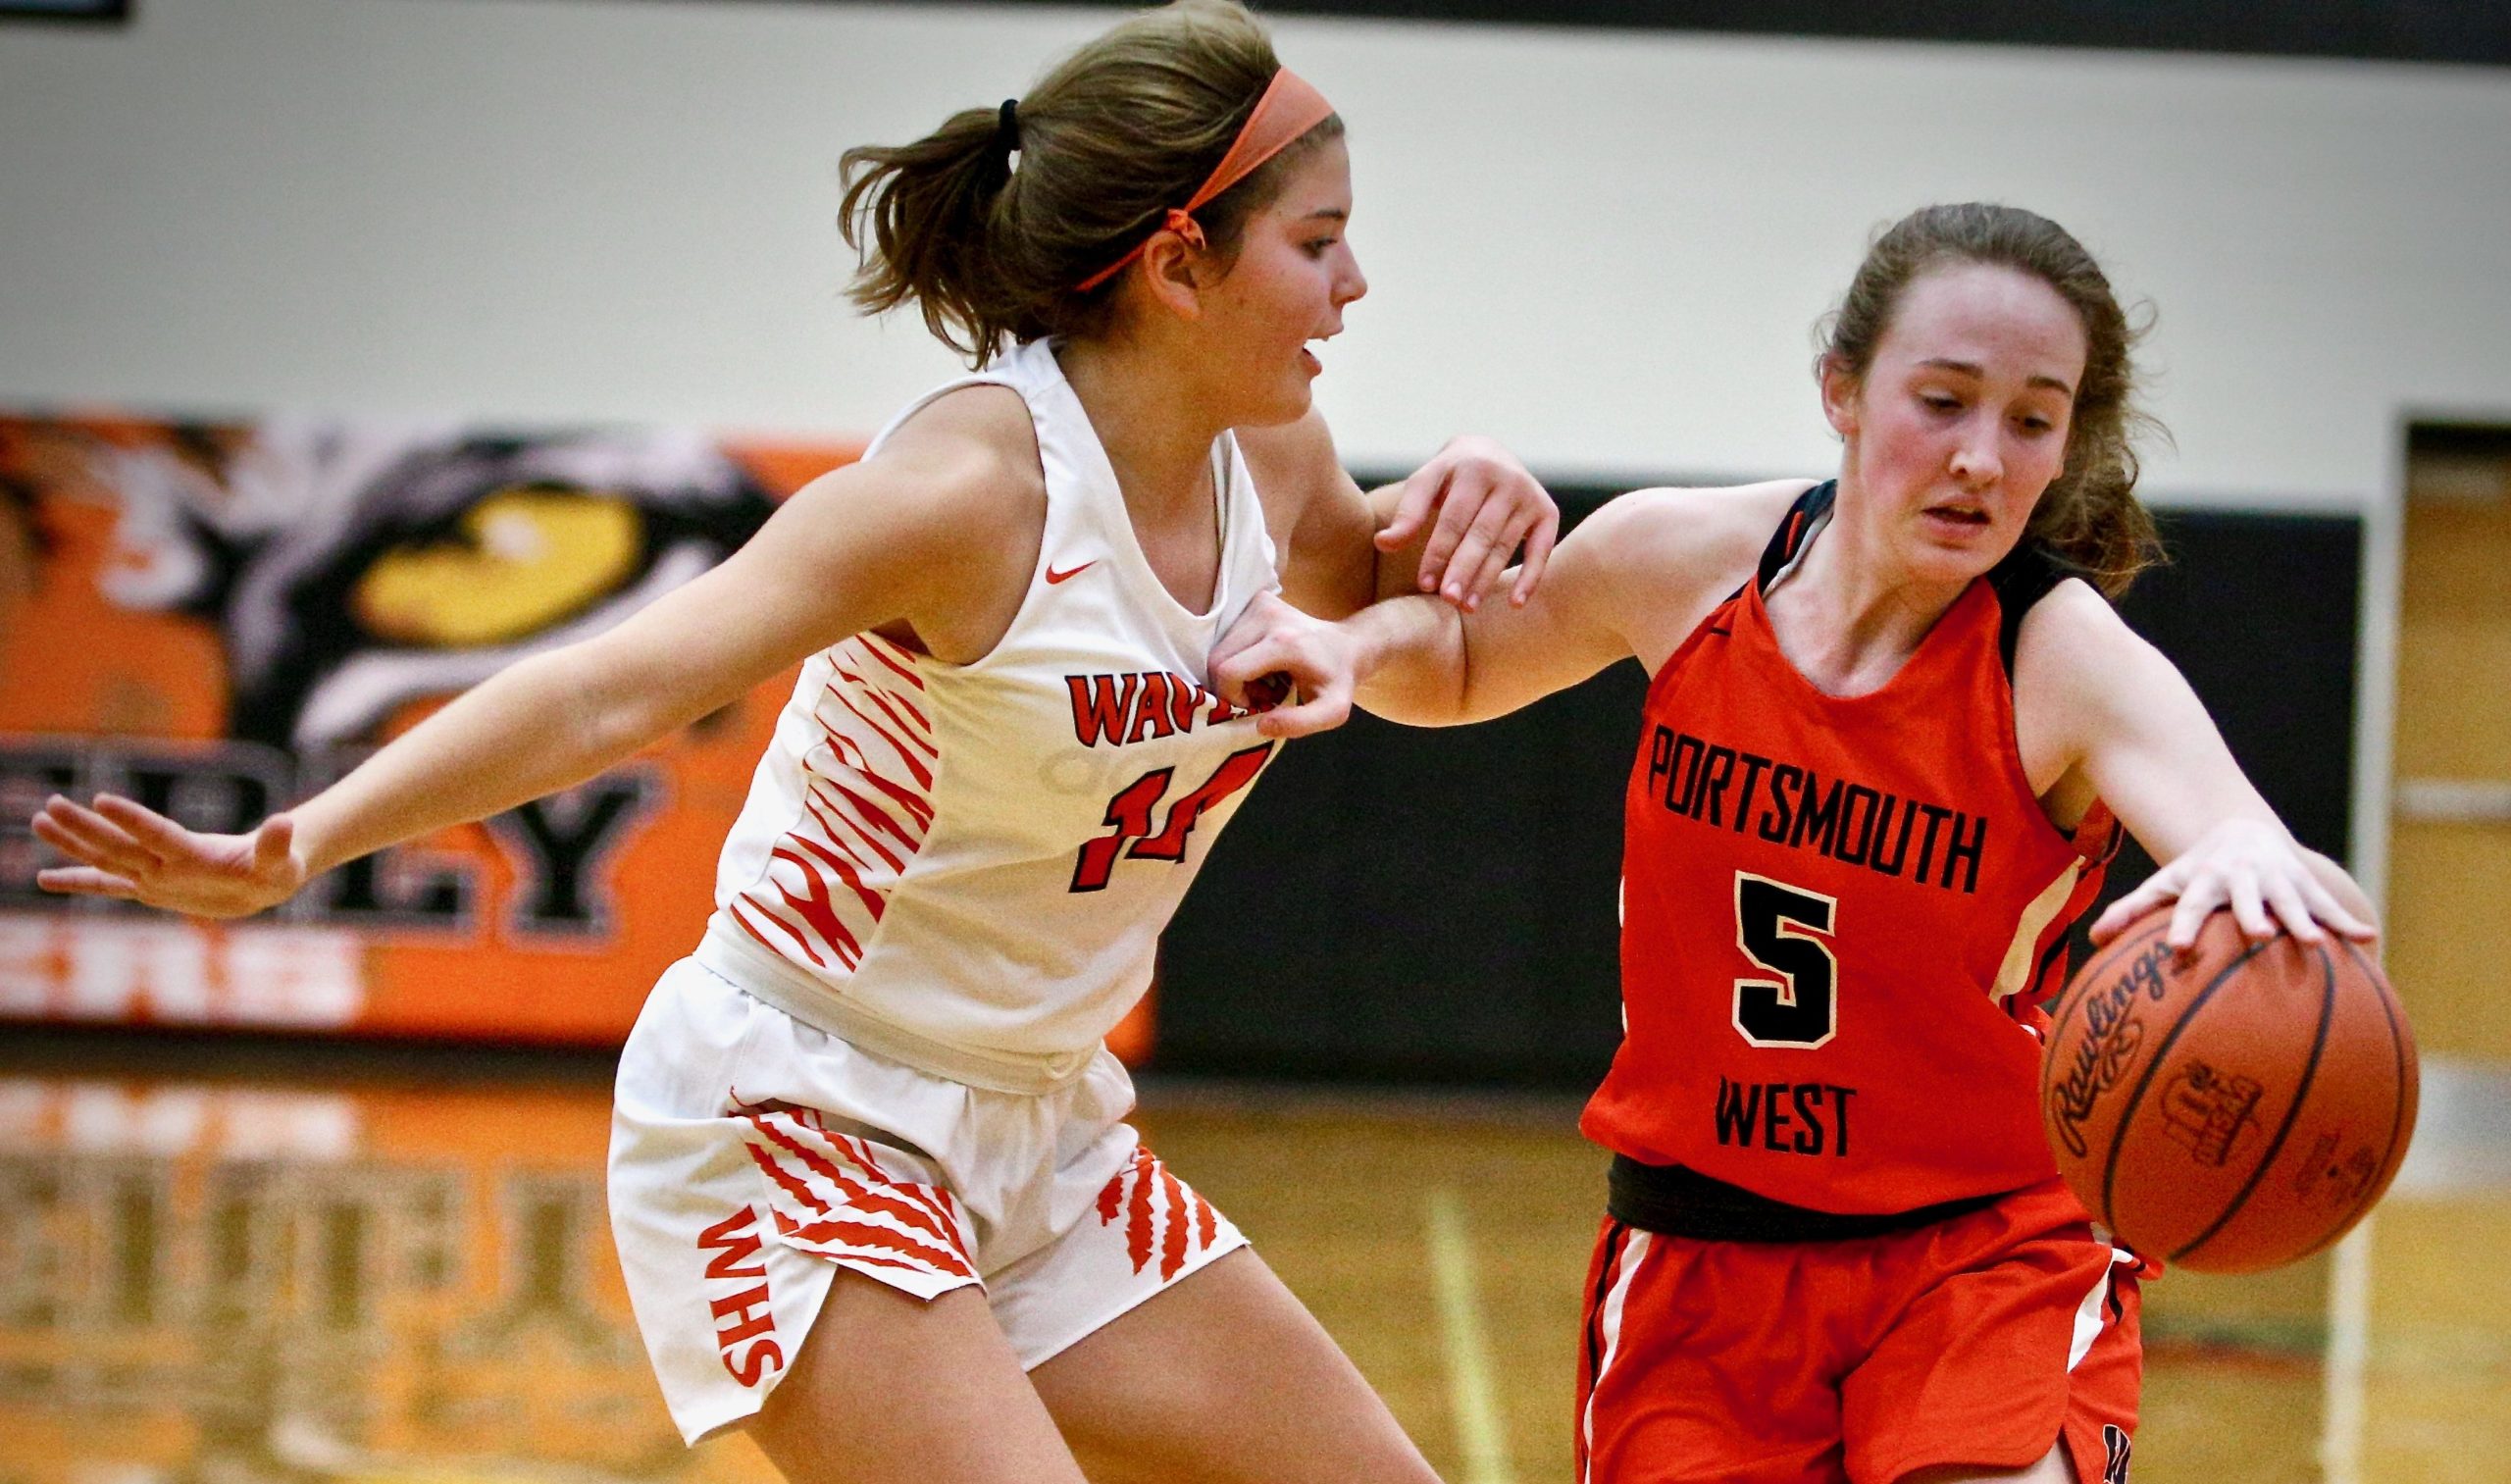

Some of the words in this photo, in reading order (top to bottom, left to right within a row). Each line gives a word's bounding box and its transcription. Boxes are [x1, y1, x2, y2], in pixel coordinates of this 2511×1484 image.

[1649, 723, 1987, 895] PORTSMOUTH
[1732, 869, 1837, 1050] 5
[2051, 938, 2177, 1159] Rawlings
[1715, 1074, 1858, 1157] WEST
[696, 1203, 784, 1388] WHS
